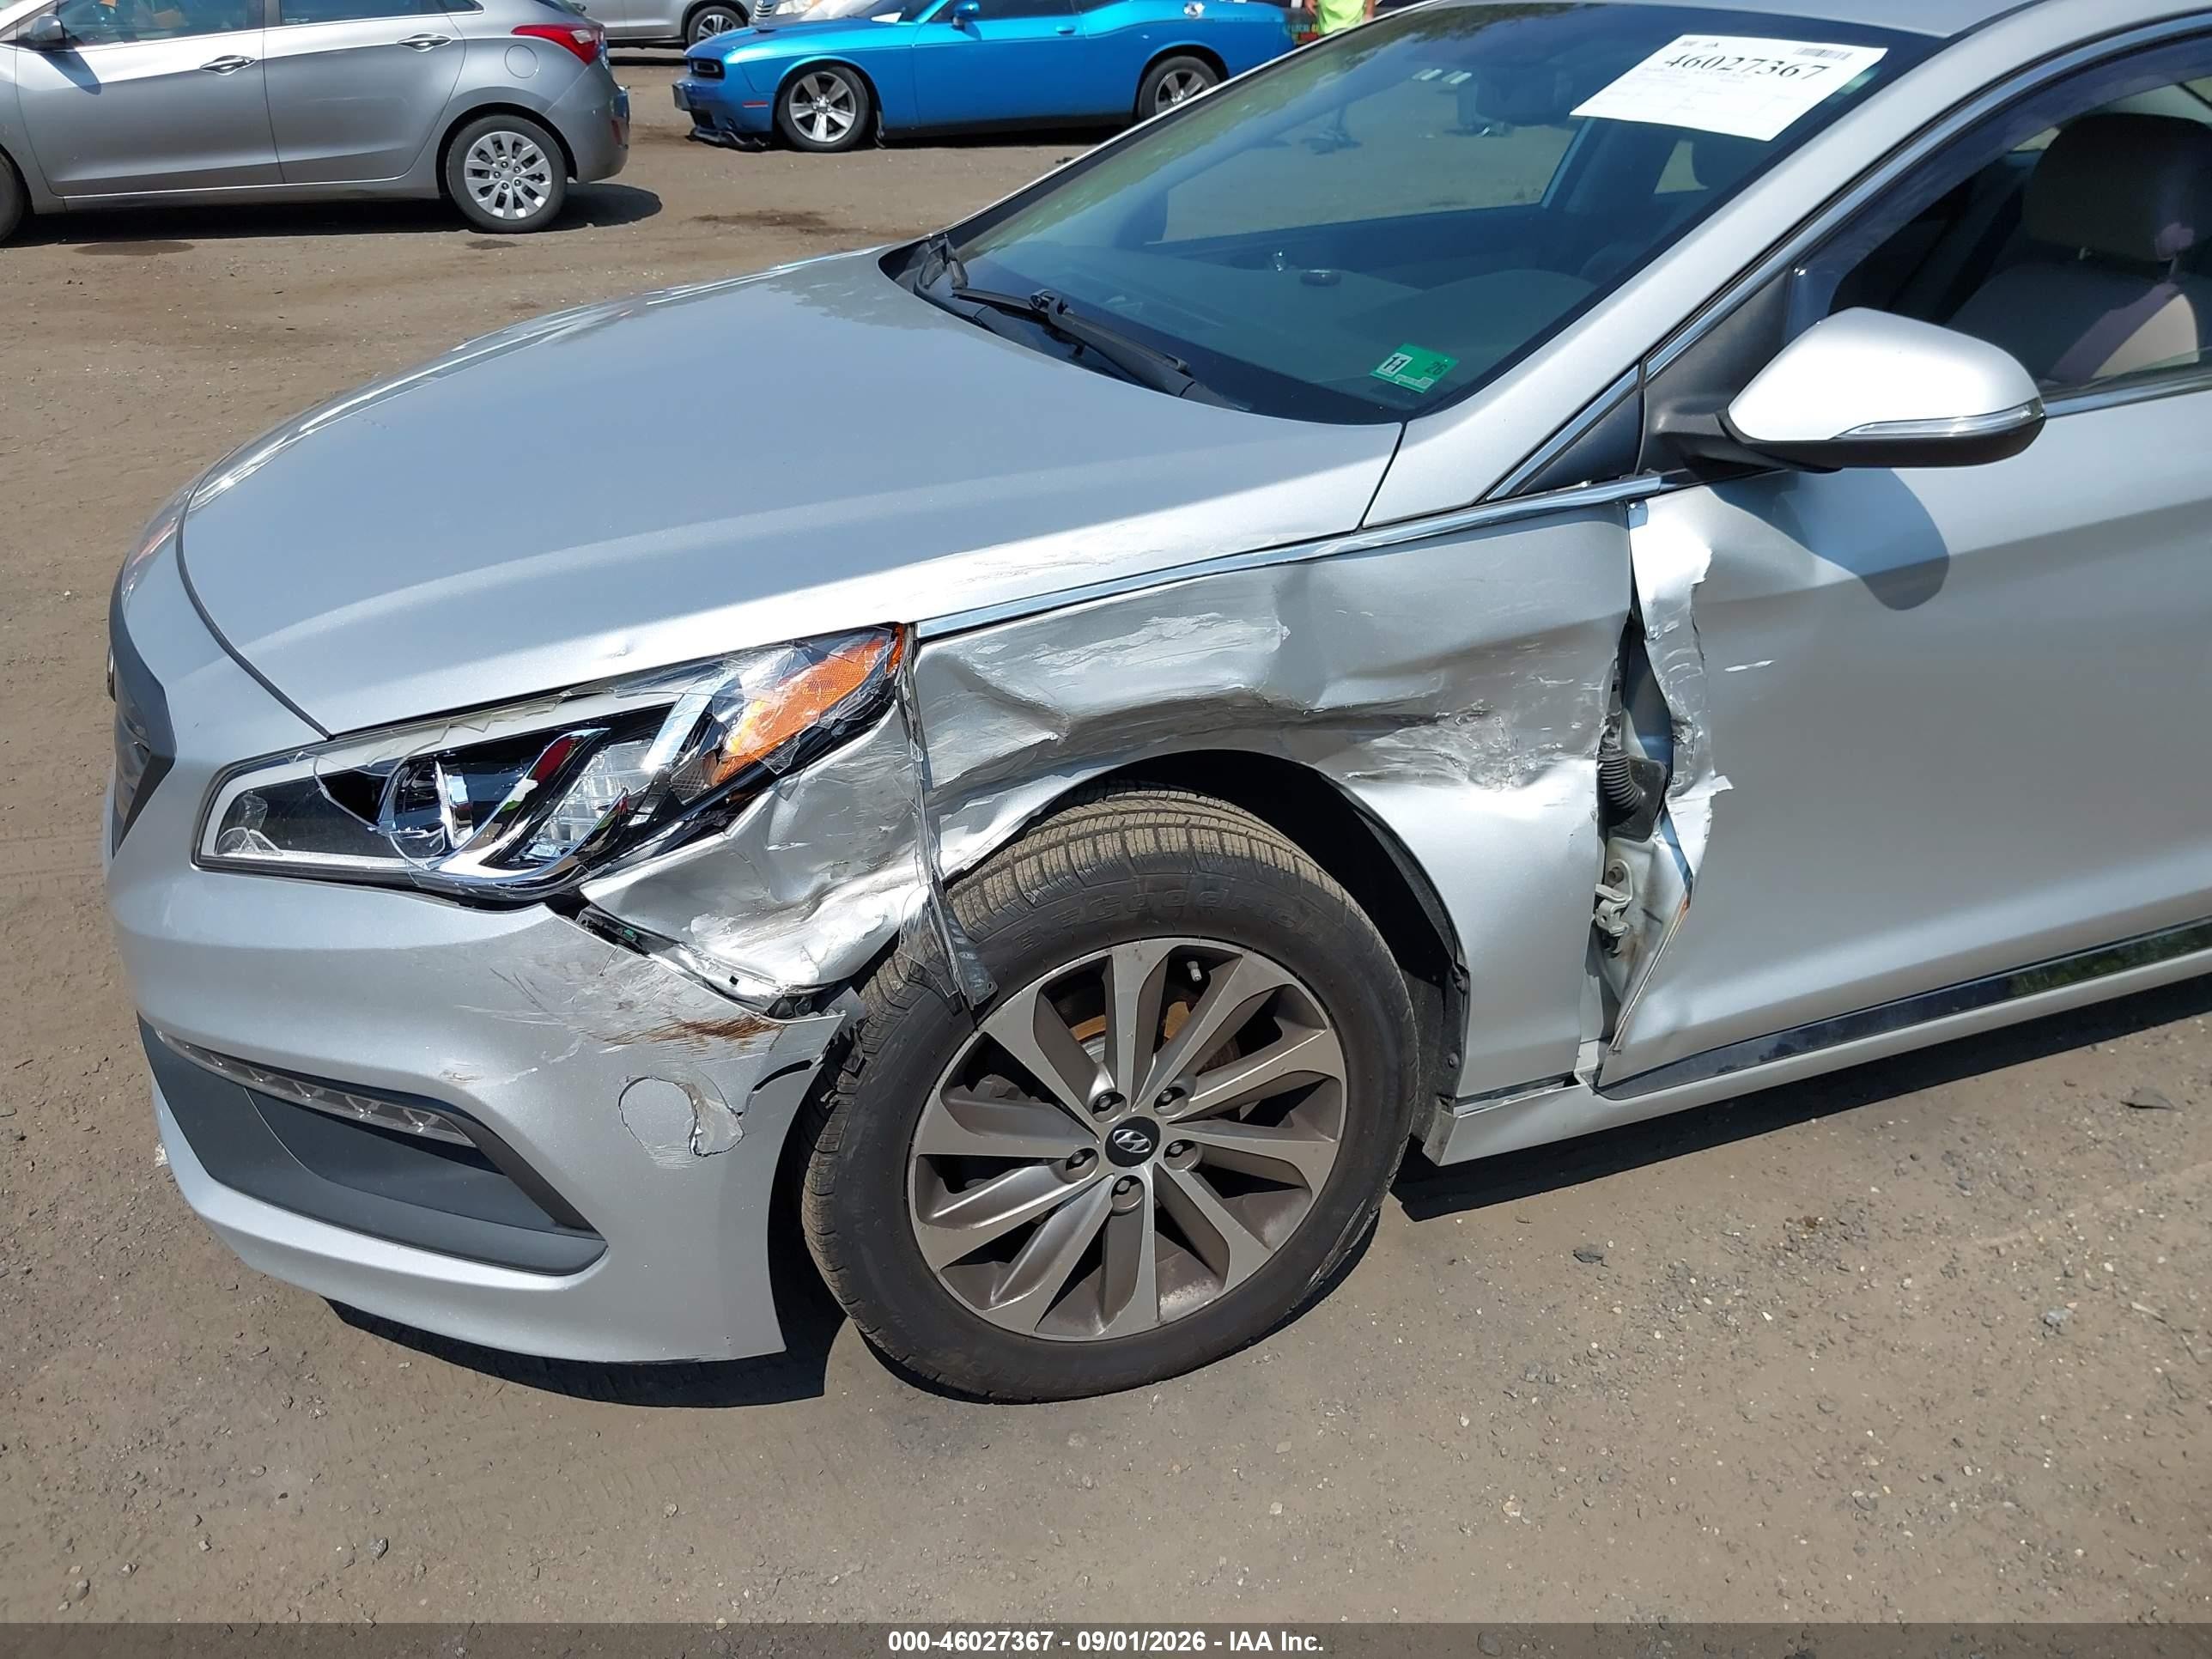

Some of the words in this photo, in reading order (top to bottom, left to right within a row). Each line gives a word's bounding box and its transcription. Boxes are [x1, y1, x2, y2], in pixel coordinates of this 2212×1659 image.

[1664, 52, 1831, 81] 46027367
[1383, 356, 1408, 373] 11
[1425, 362, 1448, 375] 26
